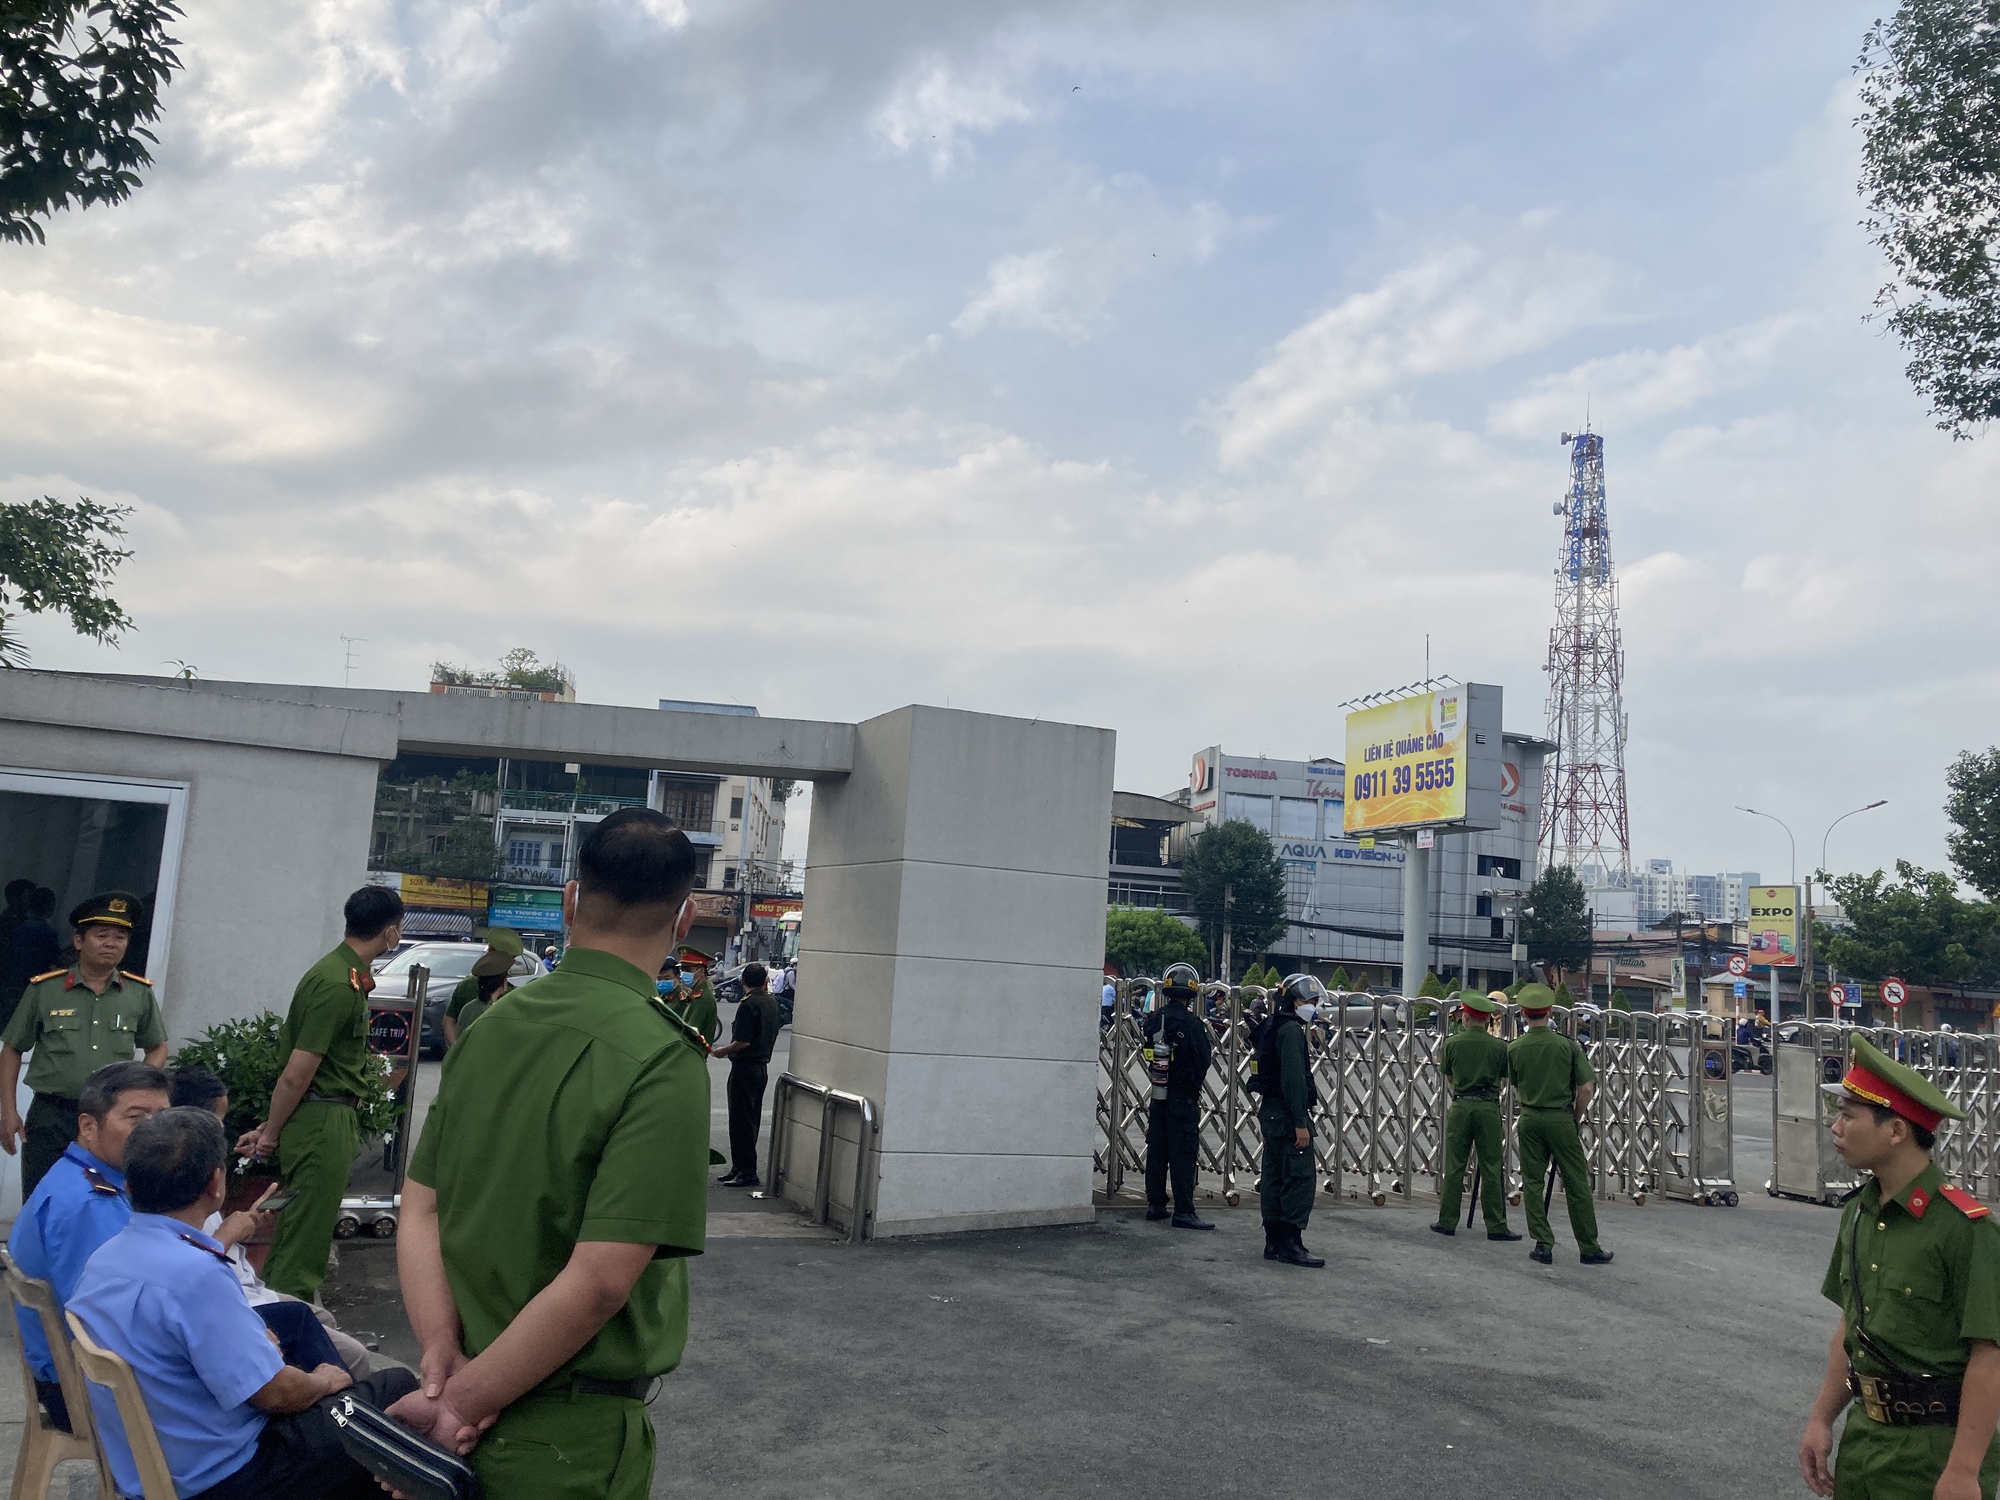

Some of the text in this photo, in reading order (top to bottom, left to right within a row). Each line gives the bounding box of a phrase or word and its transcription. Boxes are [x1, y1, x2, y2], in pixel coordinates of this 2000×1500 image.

[1364, 730, 1444, 763] LIÊN HỆ QUẢNG CÁO
[1225, 767, 1278, 781] TOSHIBA
[1354, 757, 1455, 801] 0911 39 5555
[1280, 843, 1327, 859] AQUA
[755, 904, 774, 912] KHU
[1751, 907, 1794, 917] EXPO
[371, 1027, 405, 1038] SAFE TRIP
